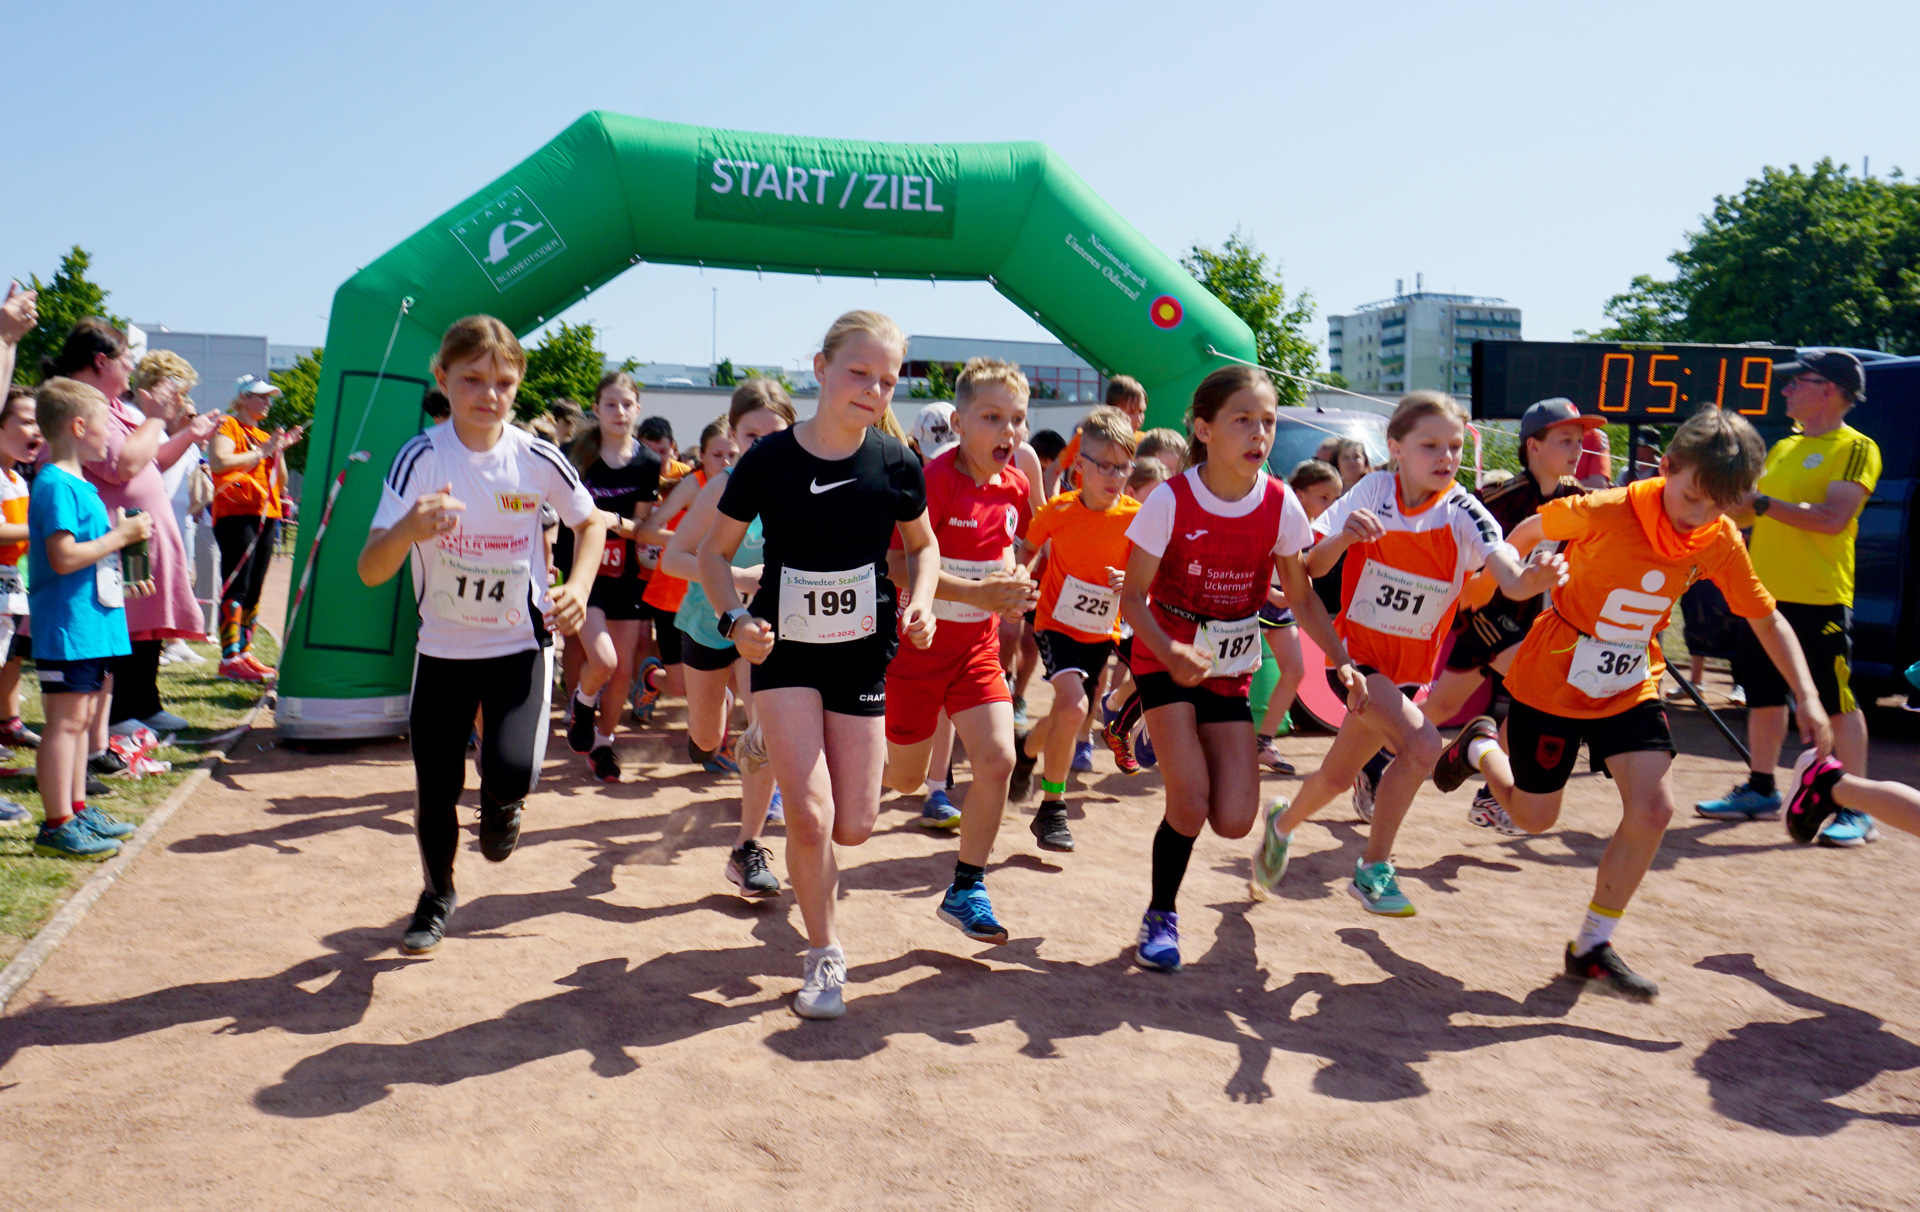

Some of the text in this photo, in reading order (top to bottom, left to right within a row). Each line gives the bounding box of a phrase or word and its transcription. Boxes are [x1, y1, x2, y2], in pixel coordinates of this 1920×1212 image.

[711, 157, 835, 205] START
[863, 174, 944, 212] ZIEL
[1598, 353, 1773, 415] 05:19
[948, 516, 978, 529] Marvin
[484, 541, 509, 550] UNION
[786, 570, 871, 586] 3. Schwedter Stadtlauf
[948, 564, 983, 573] Schwedter
[1207, 568, 1255, 580] Sparkasse
[455, 574, 506, 603] 114
[1204, 581, 1253, 591] Uckermark
[1376, 569, 1414, 586] Schwedter
[1415, 582, 1449, 595] Stadtlauf
[803, 589, 857, 617] 199
[1074, 594, 1111, 617] 225
[1375, 584, 1426, 615] 351
[1218, 634, 1255, 659] 187
[1597, 650, 1642, 676] 361
